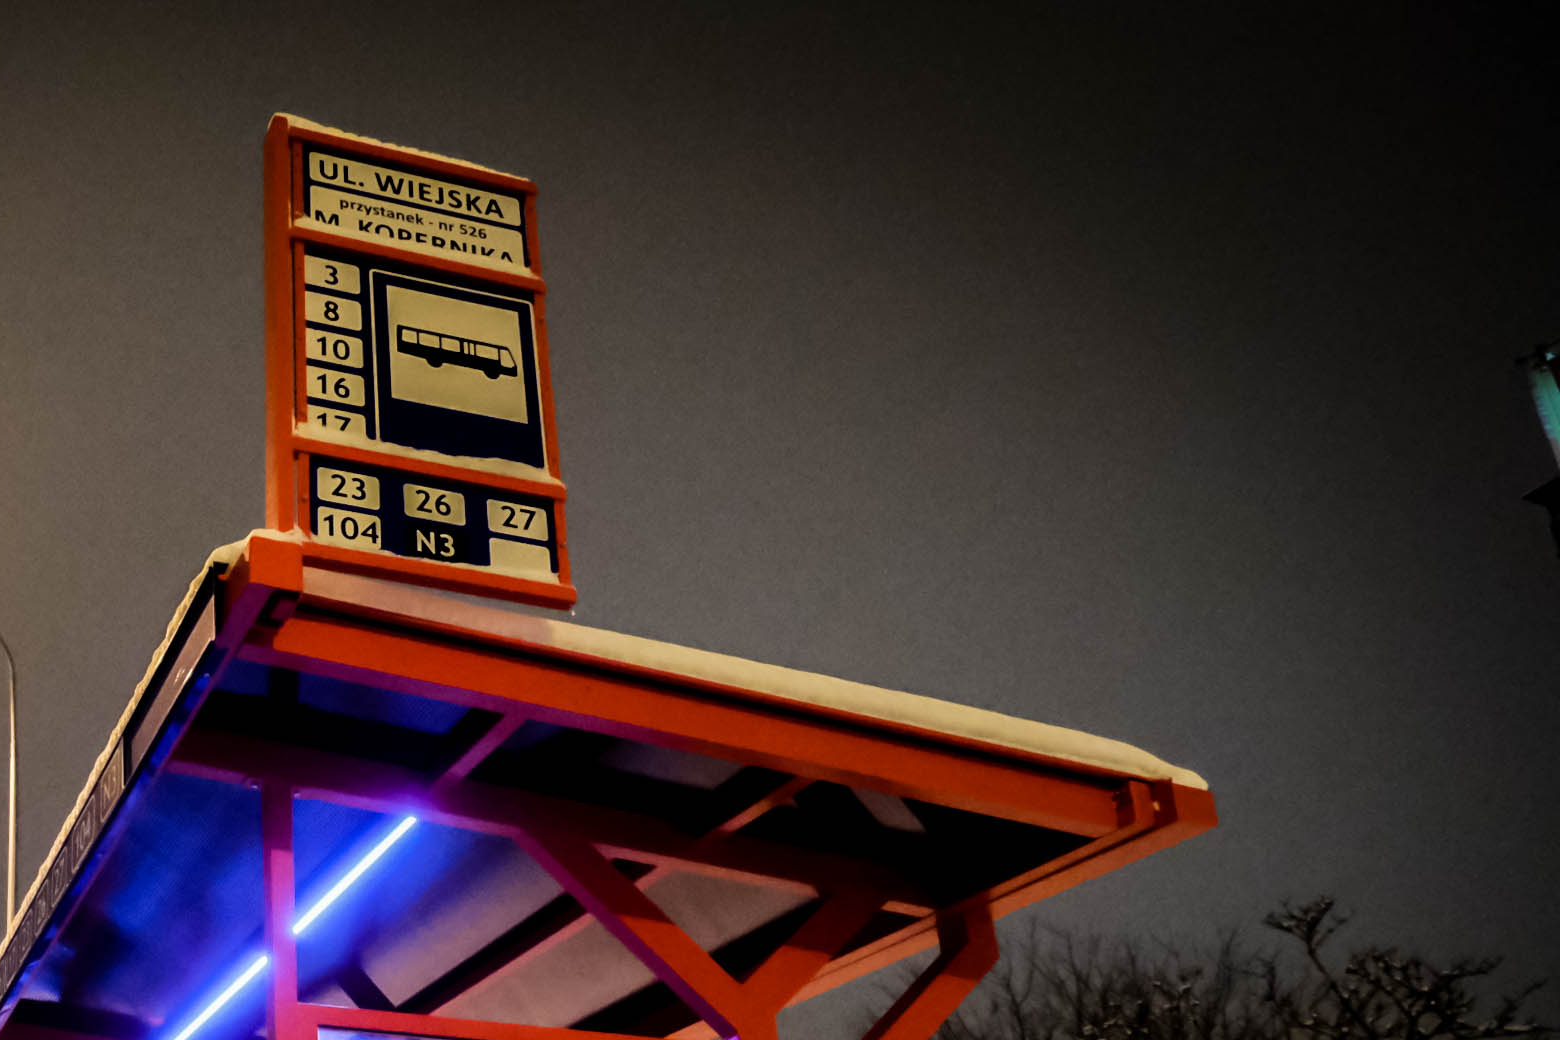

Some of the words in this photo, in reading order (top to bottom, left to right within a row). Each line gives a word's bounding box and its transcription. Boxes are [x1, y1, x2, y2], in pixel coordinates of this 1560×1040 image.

[318, 159, 365, 187] UL.
[375, 171, 505, 219] WIEJSKA
[339, 198, 425, 226] przystanek
[438, 220, 454, 232] nr
[459, 223, 487, 240] 526
[324, 264, 339, 286] 3
[323, 300, 340, 322] 8
[316, 336, 351, 361] 10
[316, 373, 351, 399] 16
[316, 412, 352, 432] 17
[330, 473, 367, 501] 23
[415, 489, 452, 517] 26
[322, 513, 379, 545] 104
[500, 505, 537, 531] 27
[416, 529, 456, 558] N3
